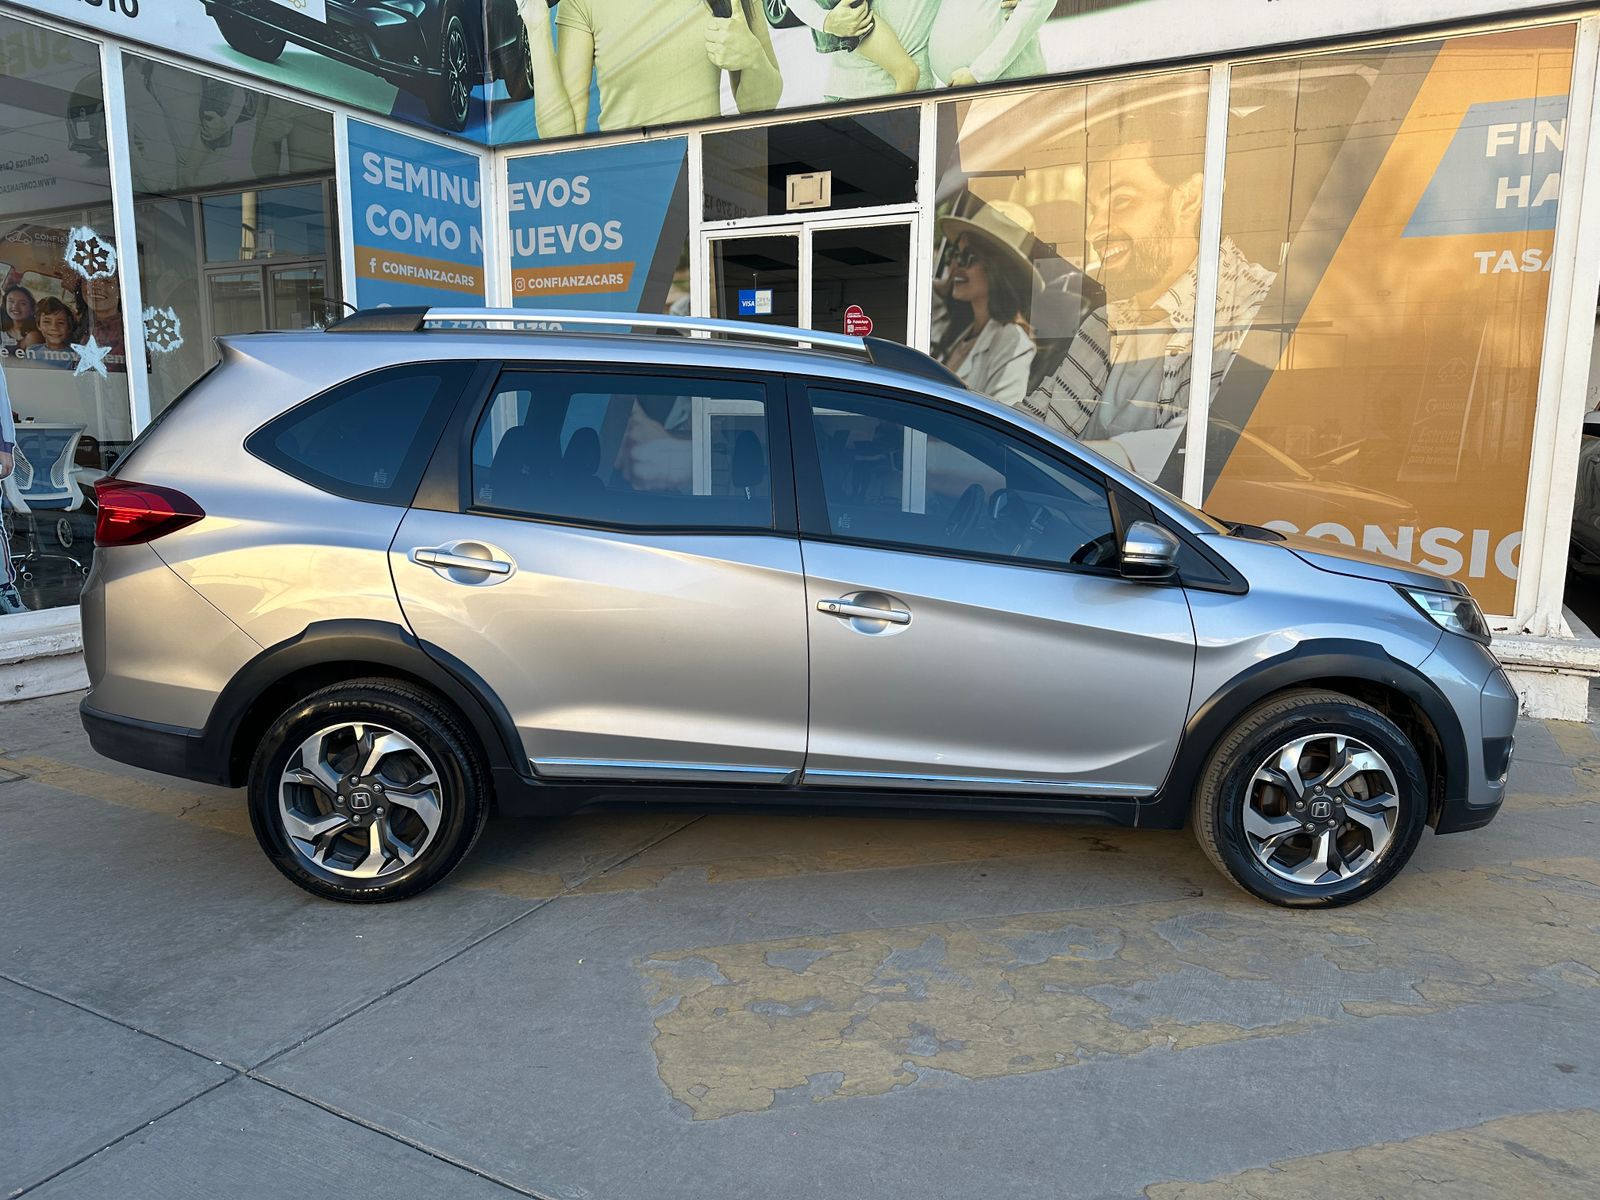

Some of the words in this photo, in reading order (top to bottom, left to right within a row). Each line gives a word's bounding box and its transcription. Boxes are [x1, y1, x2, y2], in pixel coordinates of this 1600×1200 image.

[1486, 118, 1567, 157] FIN
[365, 204, 461, 250] COMO
[382, 261, 475, 287] CONFIANZACARS
[1473, 249, 1553, 274] TAS
[528, 274, 624, 290] CONFIANZACARS
[15, 348, 37, 360] en
[1260, 520, 1523, 580] NSI
